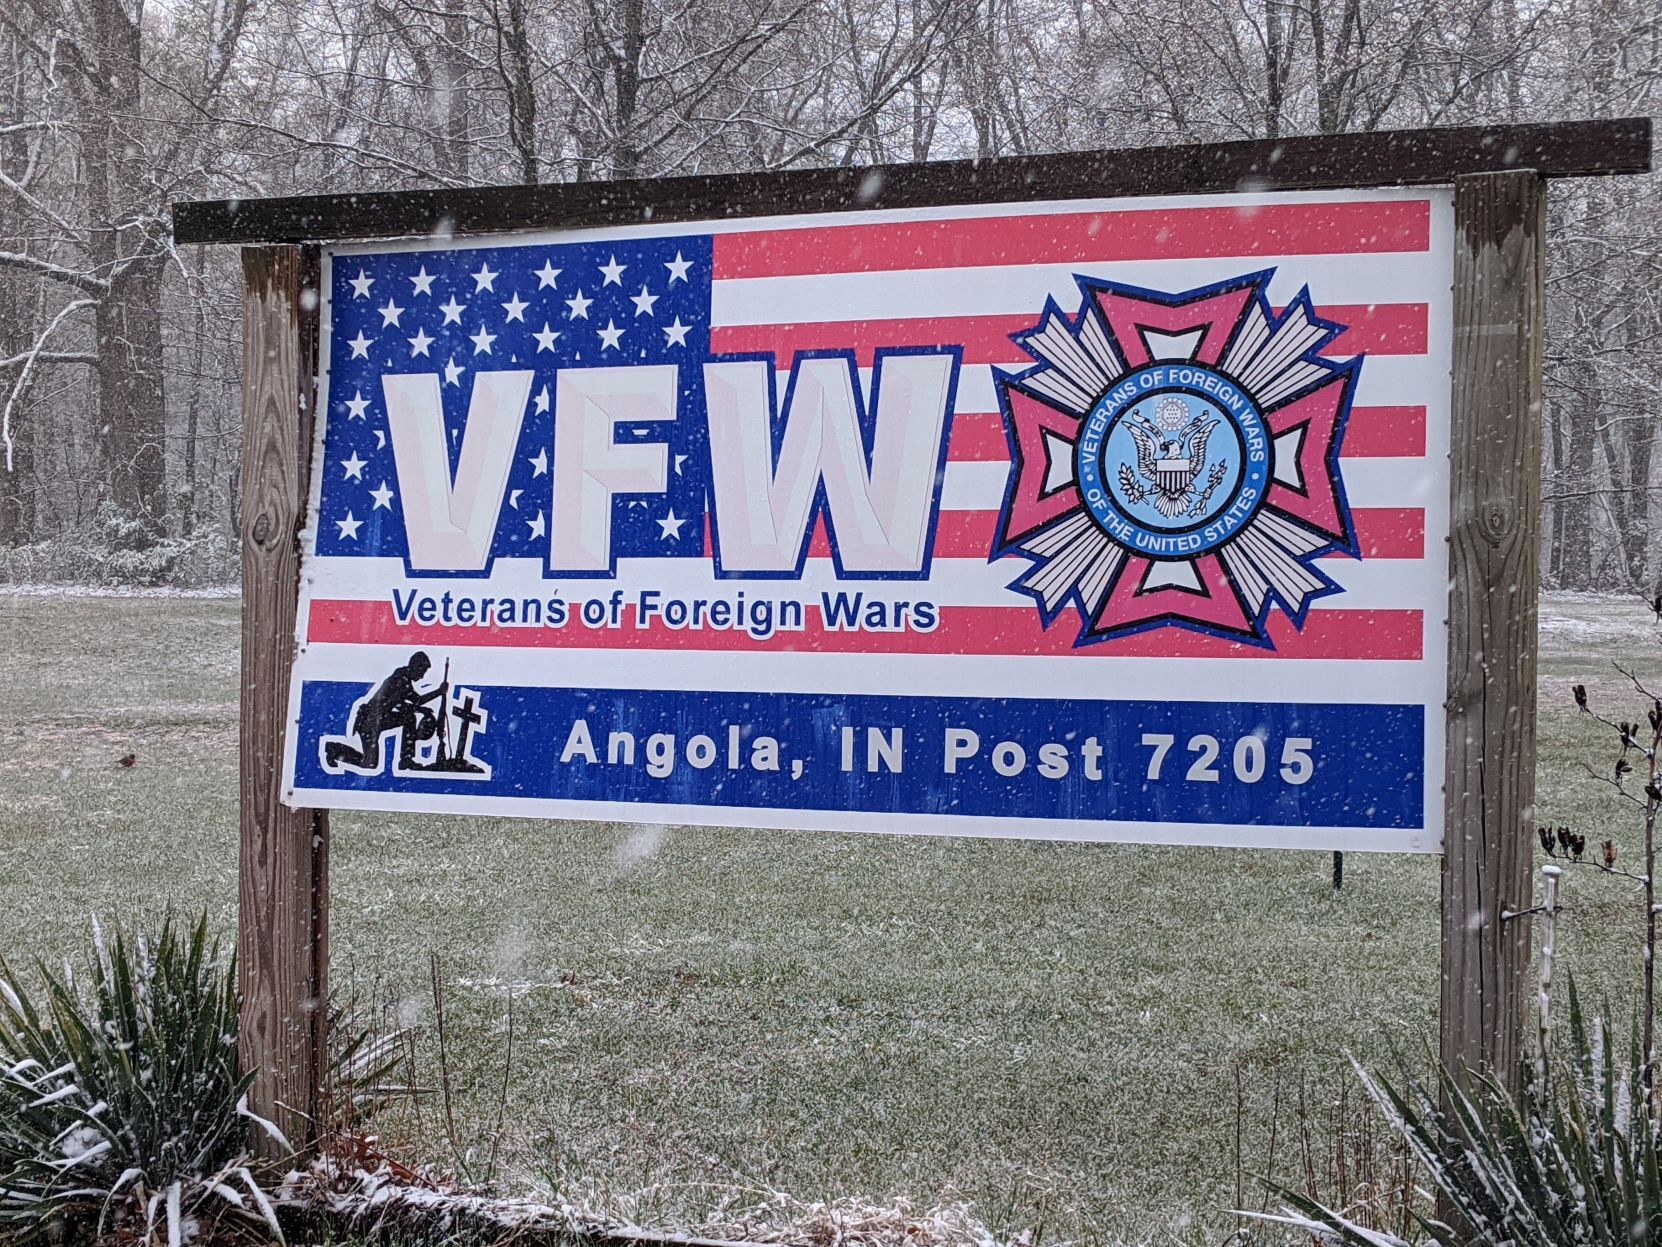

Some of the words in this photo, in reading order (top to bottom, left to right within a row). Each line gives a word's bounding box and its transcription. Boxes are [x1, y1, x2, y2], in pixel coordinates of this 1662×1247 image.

[1081, 382, 1138, 465] VETERANS
[1139, 369, 1164, 389] OF
[1168, 369, 1243, 409] FOREIGN
[1238, 408, 1265, 463] WARS
[380, 354, 956, 572] VFW
[1087, 488, 1108, 511] OF
[1103, 507, 1134, 542] THE
[1135, 532, 1202, 552] UNITED
[1205, 487, 1257, 542] STATES
[392, 588, 567, 626] Veterans
[582, 590, 624, 628] of
[637, 591, 803, 636] Foreign
[820, 591, 937, 630] Wars
[559, 718, 805, 781] Angola,
[840, 726, 903, 774] IN
[943, 728, 1104, 781] Post
[1140, 733, 1315, 785] 7205
